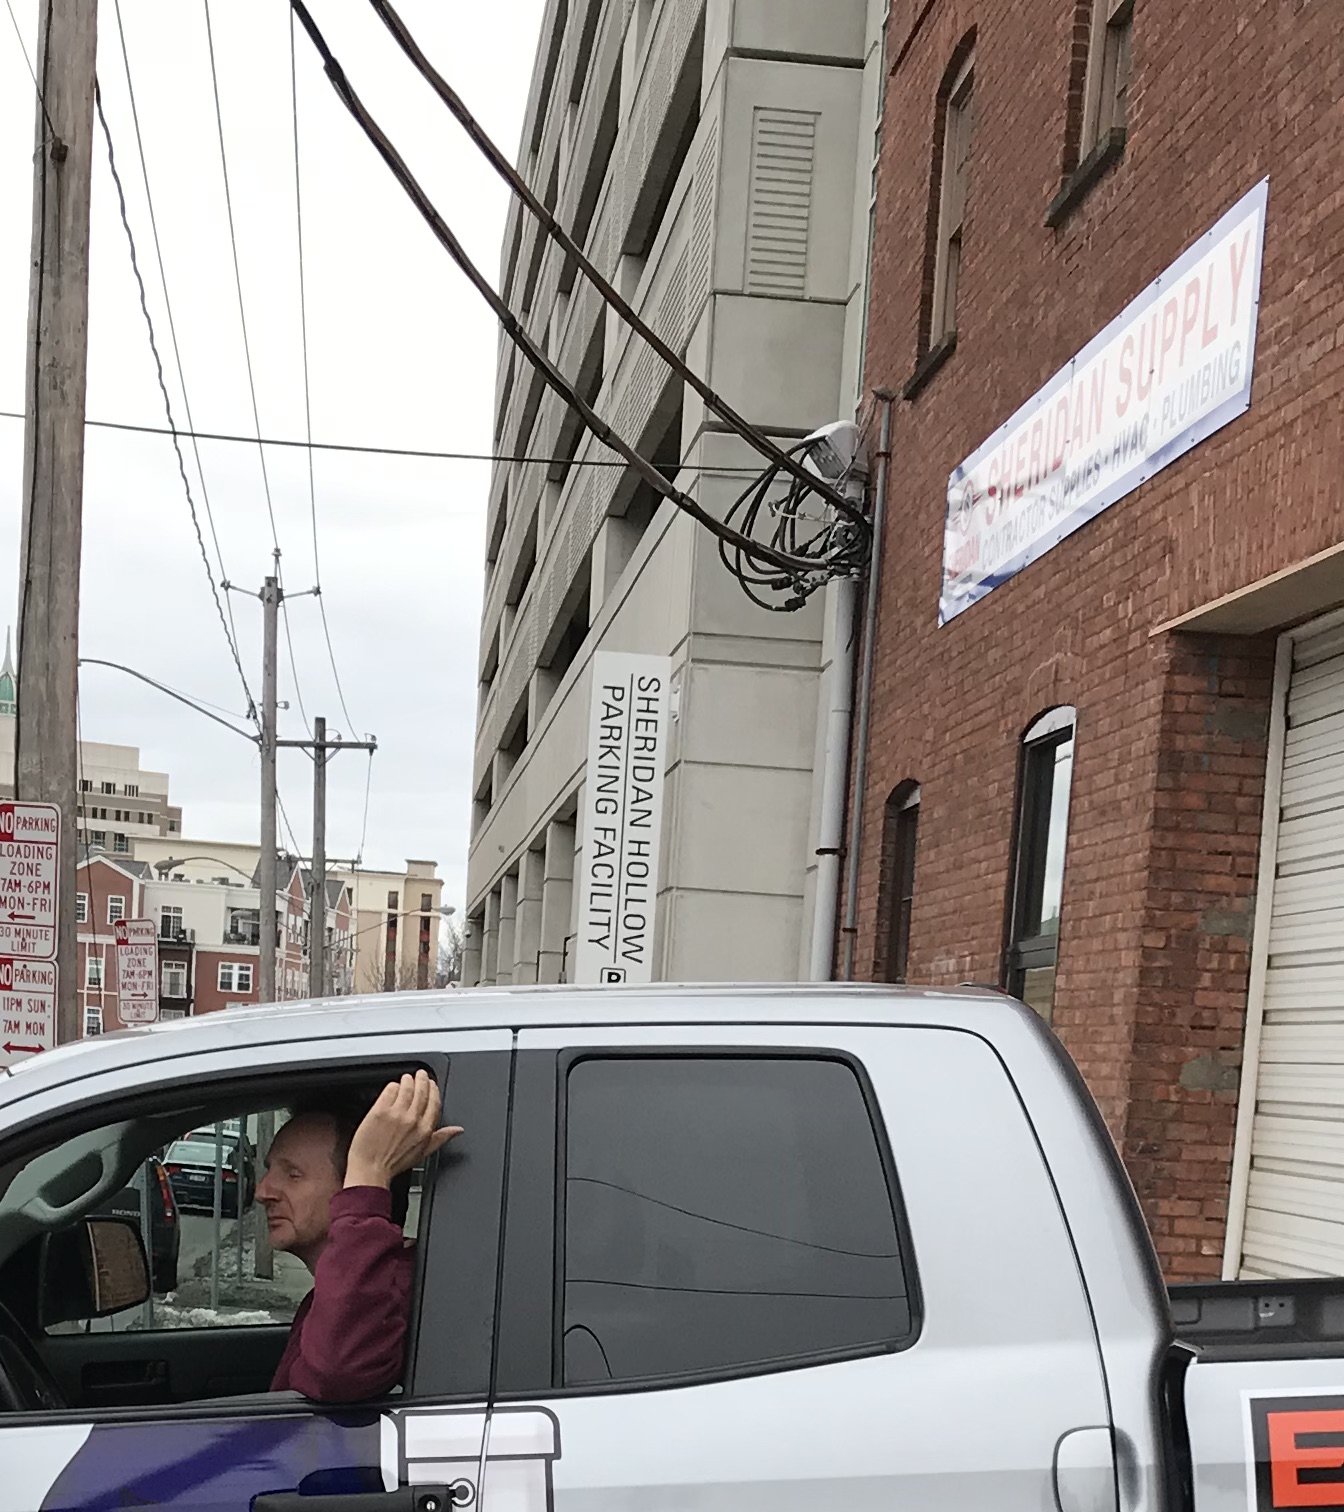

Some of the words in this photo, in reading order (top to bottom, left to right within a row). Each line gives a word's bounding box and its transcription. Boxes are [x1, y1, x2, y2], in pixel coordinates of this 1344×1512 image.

[985, 358, 1106, 525] SHERIDAN
[1116, 229, 1251, 417] SUPPLY
[982, 495, 1046, 570] CONTRACTOR
[1048, 449, 1101, 520] SUPPLIES
[1112, 412, 1149, 472] HVAC
[1161, 340, 1241, 435] PLUMBING
[595, 684, 625, 815] PARKING
[629, 676, 661, 828] SHERIDAN
[16, 816, 56, 833] PARKING
[0, 843, 53, 860] LOADING
[9, 861, 42, 877] ZONE
[0, 878, 51, 895] 7AM-6PM
[587, 827, 617, 950] FACILITY
[621, 840, 651, 964] HOLLOW
[14, 927, 50, 941] MINUTE
[116, 926, 128, 940] NO
[128, 927, 155, 937] PARKING
[11, 940, 37, 954] LIMIT
[119, 946, 154, 957] LOADING
[126, 958, 147, 968] ZONE
[14, 968, 54, 986] PARKING
[3, 997, 23, 1012] 11PM
[27, 998, 46, 1014] SUN
[3, 1019, 21, 1035] 7AM
[25, 1021, 45, 1036] MON
[112, 1209, 141, 1217] HOND
